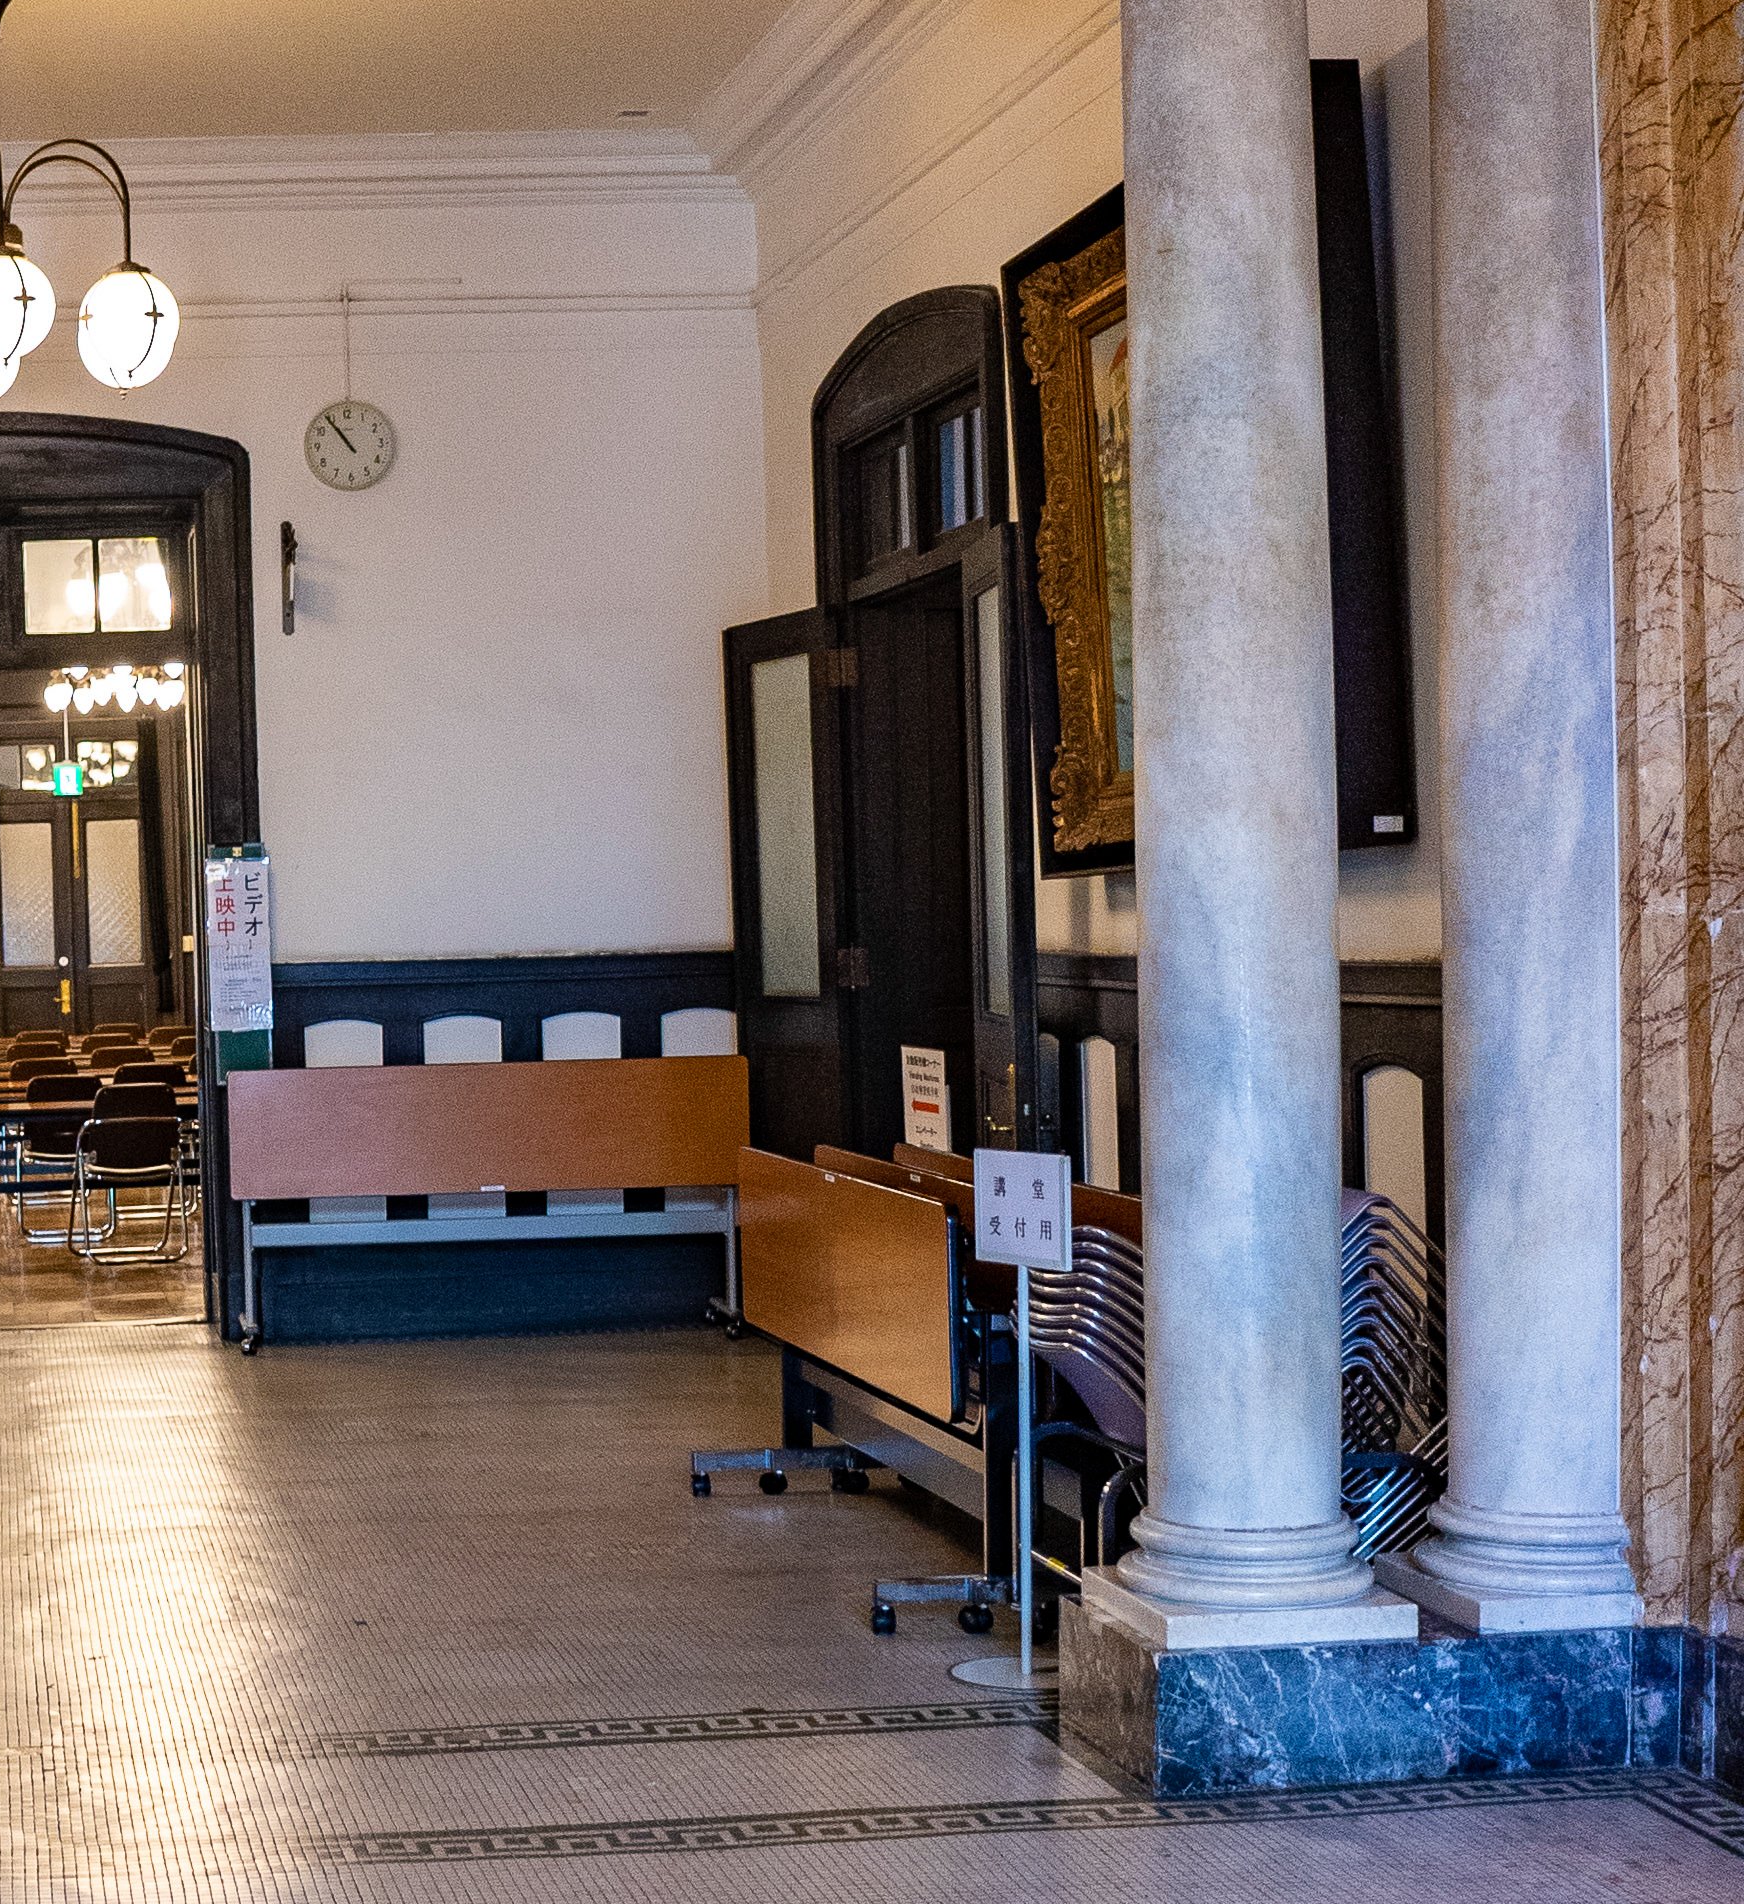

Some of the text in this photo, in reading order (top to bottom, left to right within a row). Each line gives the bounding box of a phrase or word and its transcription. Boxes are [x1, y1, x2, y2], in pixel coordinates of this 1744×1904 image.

[378, 437, 384, 448] 3
[320, 458, 327, 468] 8
[215, 877, 236, 938] 上映中
[244, 871, 264, 937] ビデオ
[993, 1176, 1045, 1200] 講堂
[989, 1215, 1053, 1241] 受付用
